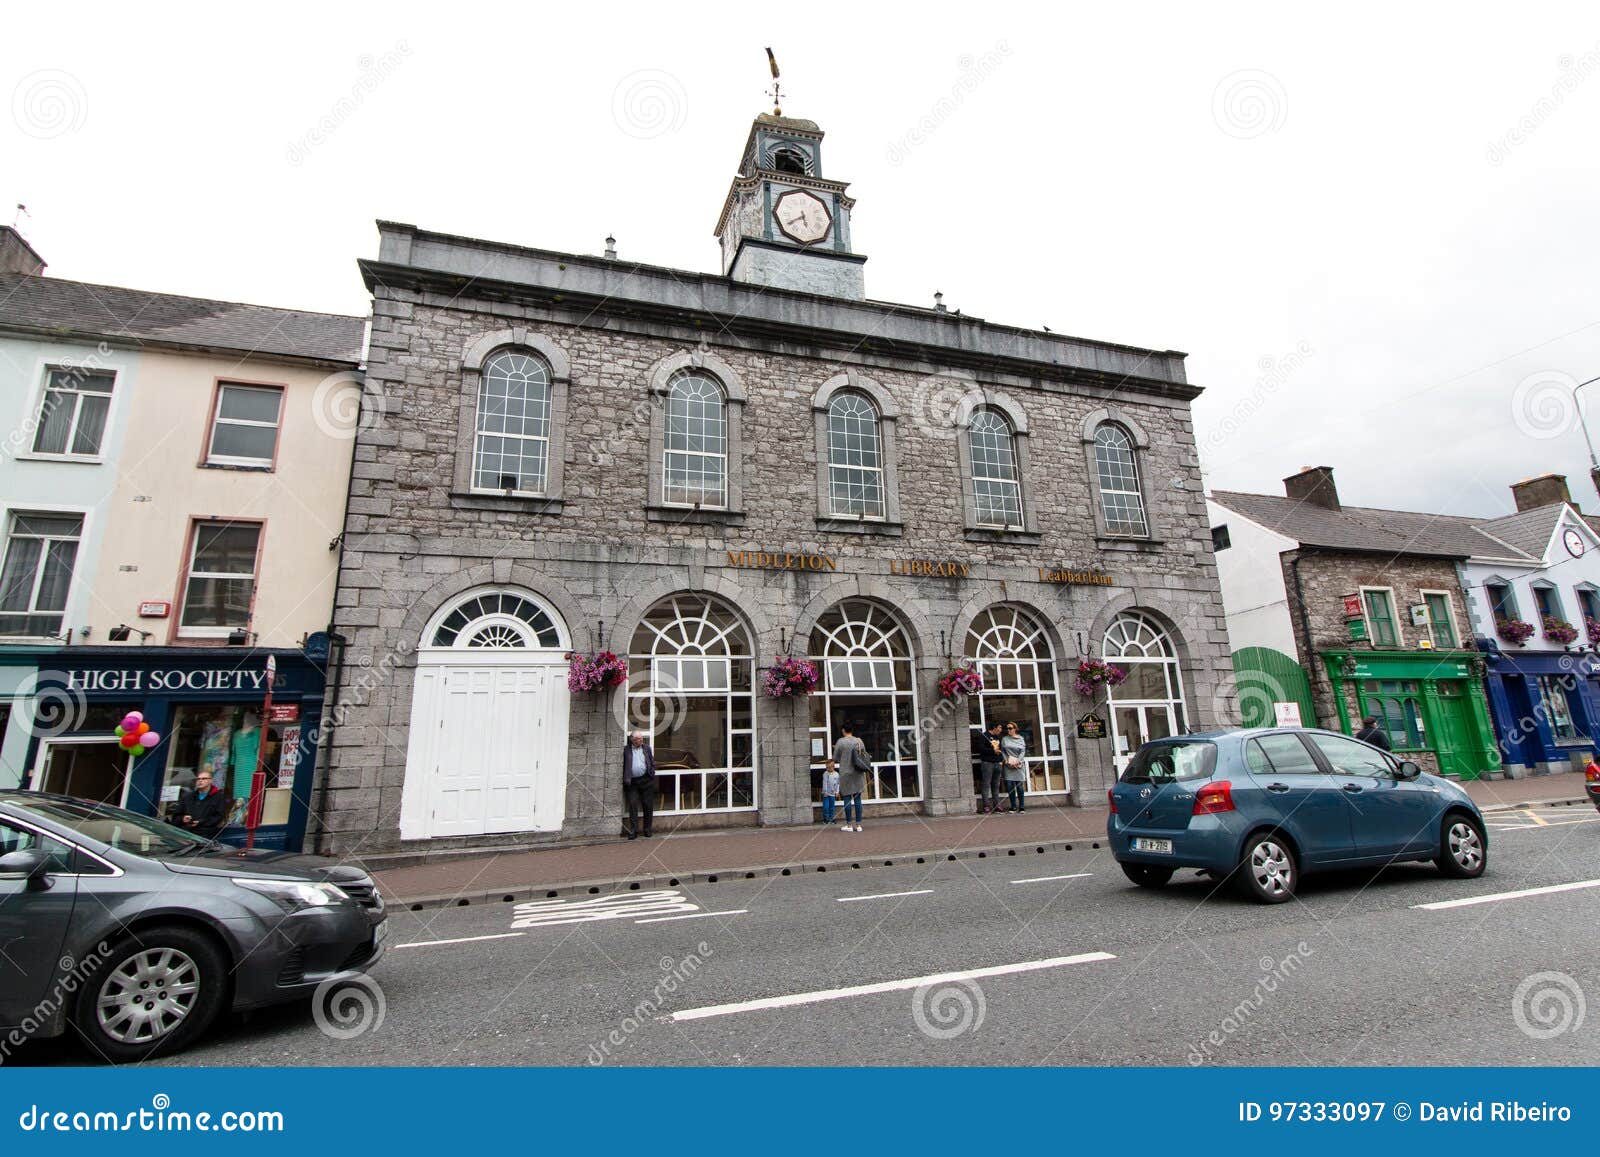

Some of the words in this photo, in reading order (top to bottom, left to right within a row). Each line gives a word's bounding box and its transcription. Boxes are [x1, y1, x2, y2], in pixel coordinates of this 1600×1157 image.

[727, 551, 837, 571] MIDLETON
[890, 559, 969, 577] LIBRARY
[67, 670, 141, 690] HIGH
[149, 670, 267, 690] SOCIETY
